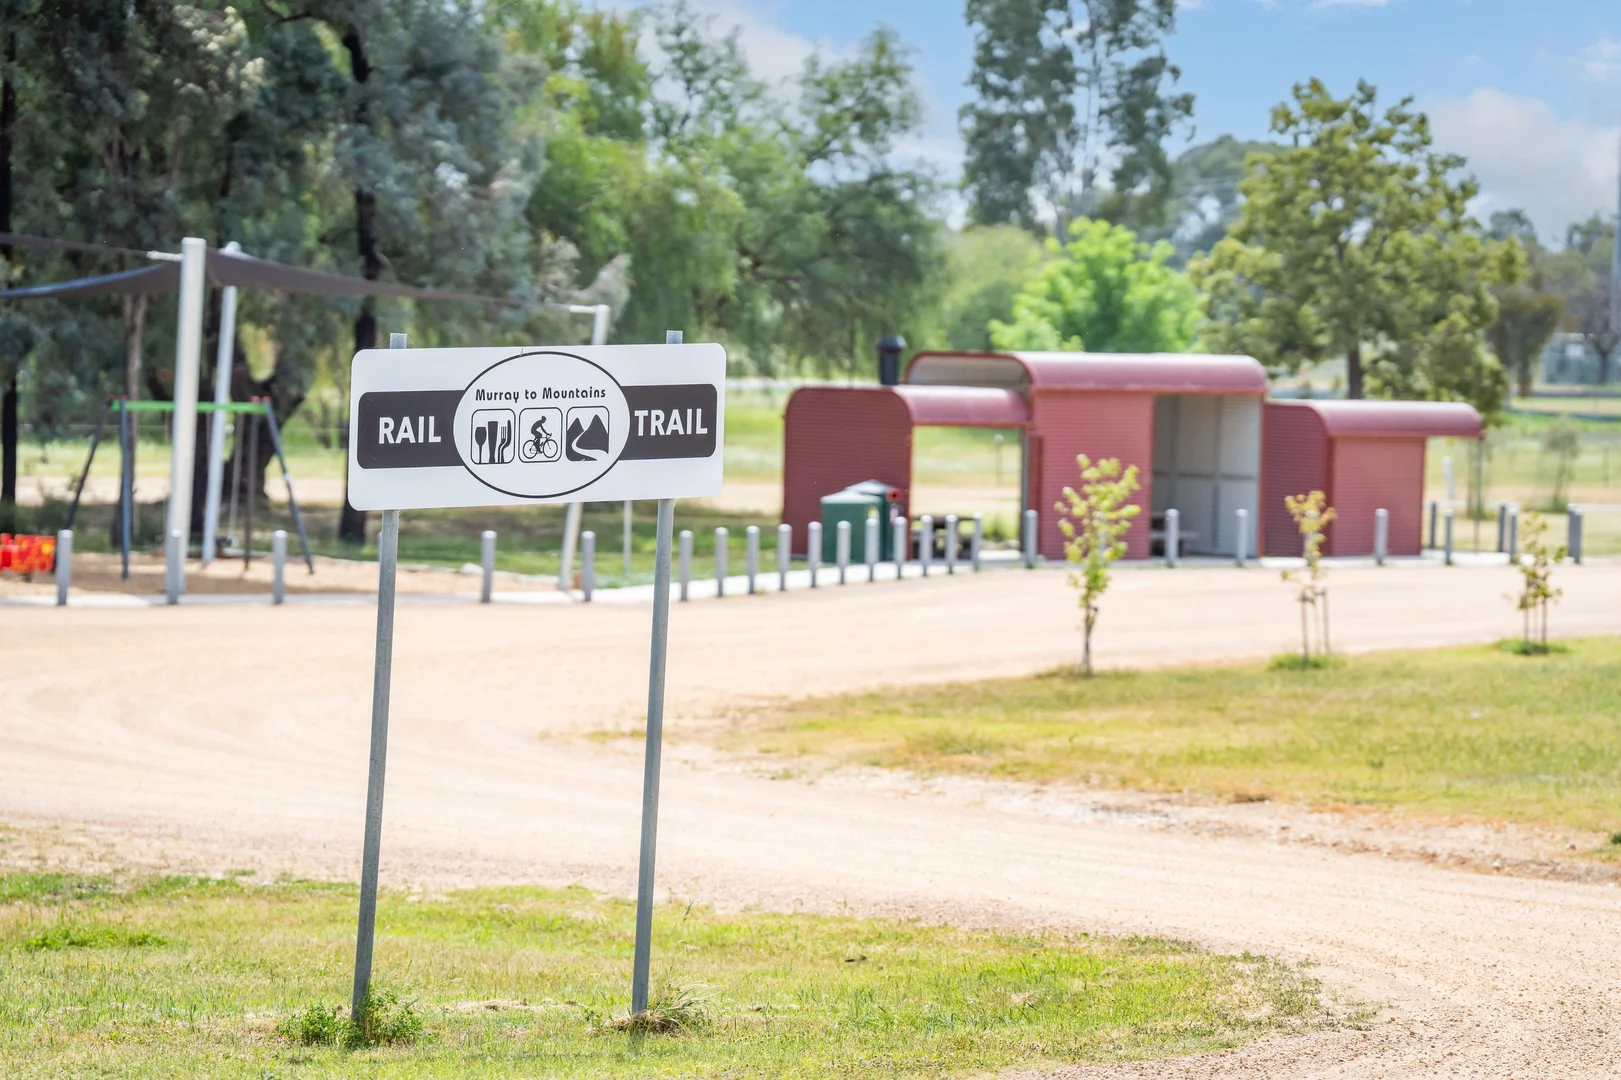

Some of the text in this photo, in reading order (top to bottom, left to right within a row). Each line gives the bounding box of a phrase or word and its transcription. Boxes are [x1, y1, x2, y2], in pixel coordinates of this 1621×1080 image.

[475, 386, 606, 403] Murray to Mountains
[378, 408, 708, 444] RAIL TRAIL
